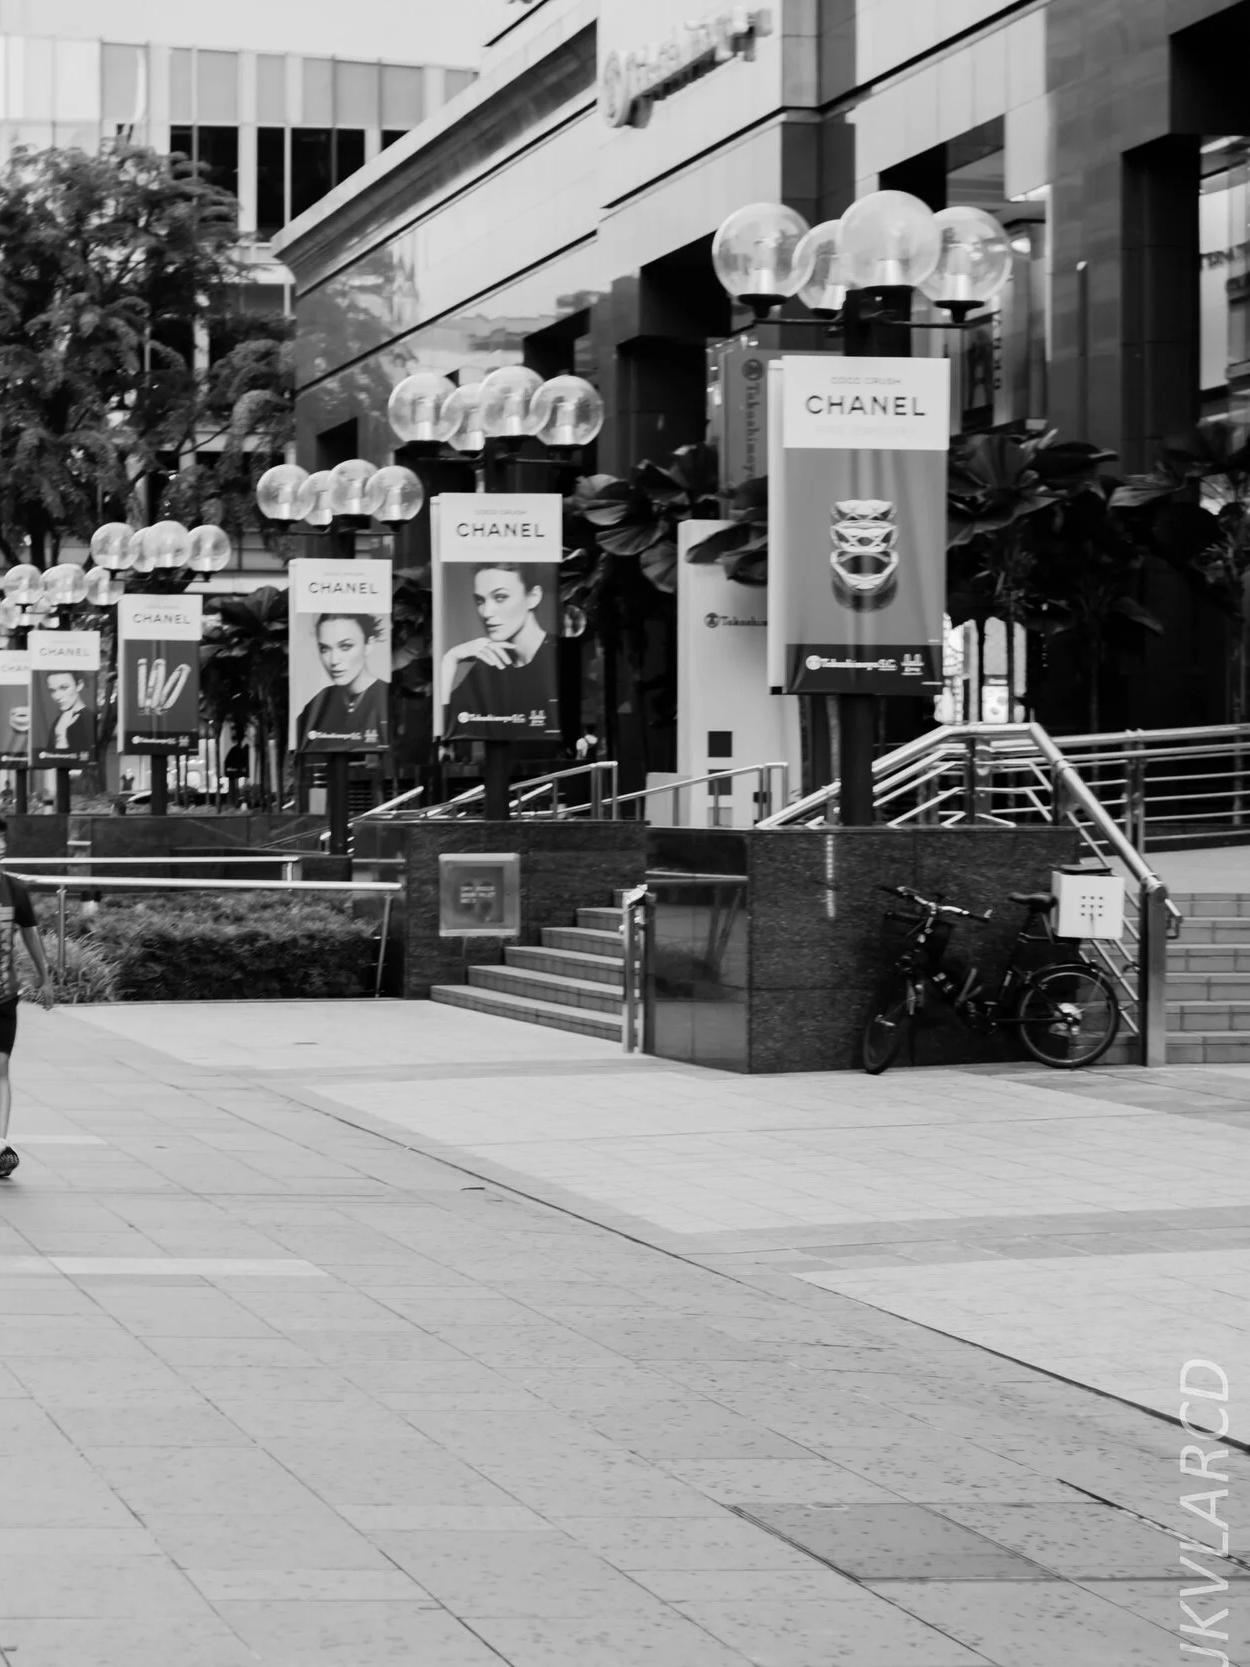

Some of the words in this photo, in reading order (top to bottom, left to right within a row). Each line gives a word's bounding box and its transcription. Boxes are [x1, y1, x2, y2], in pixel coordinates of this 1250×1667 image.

[805, 395, 926, 416] CHANEL
[456, 522, 545, 538] CHANEL
[308, 582, 379, 595] CHANEL
[132, 613, 191, 625] CHANEL
[38, 647, 91, 657] CHANEL
[0, 664, 31, 673] CHAN
